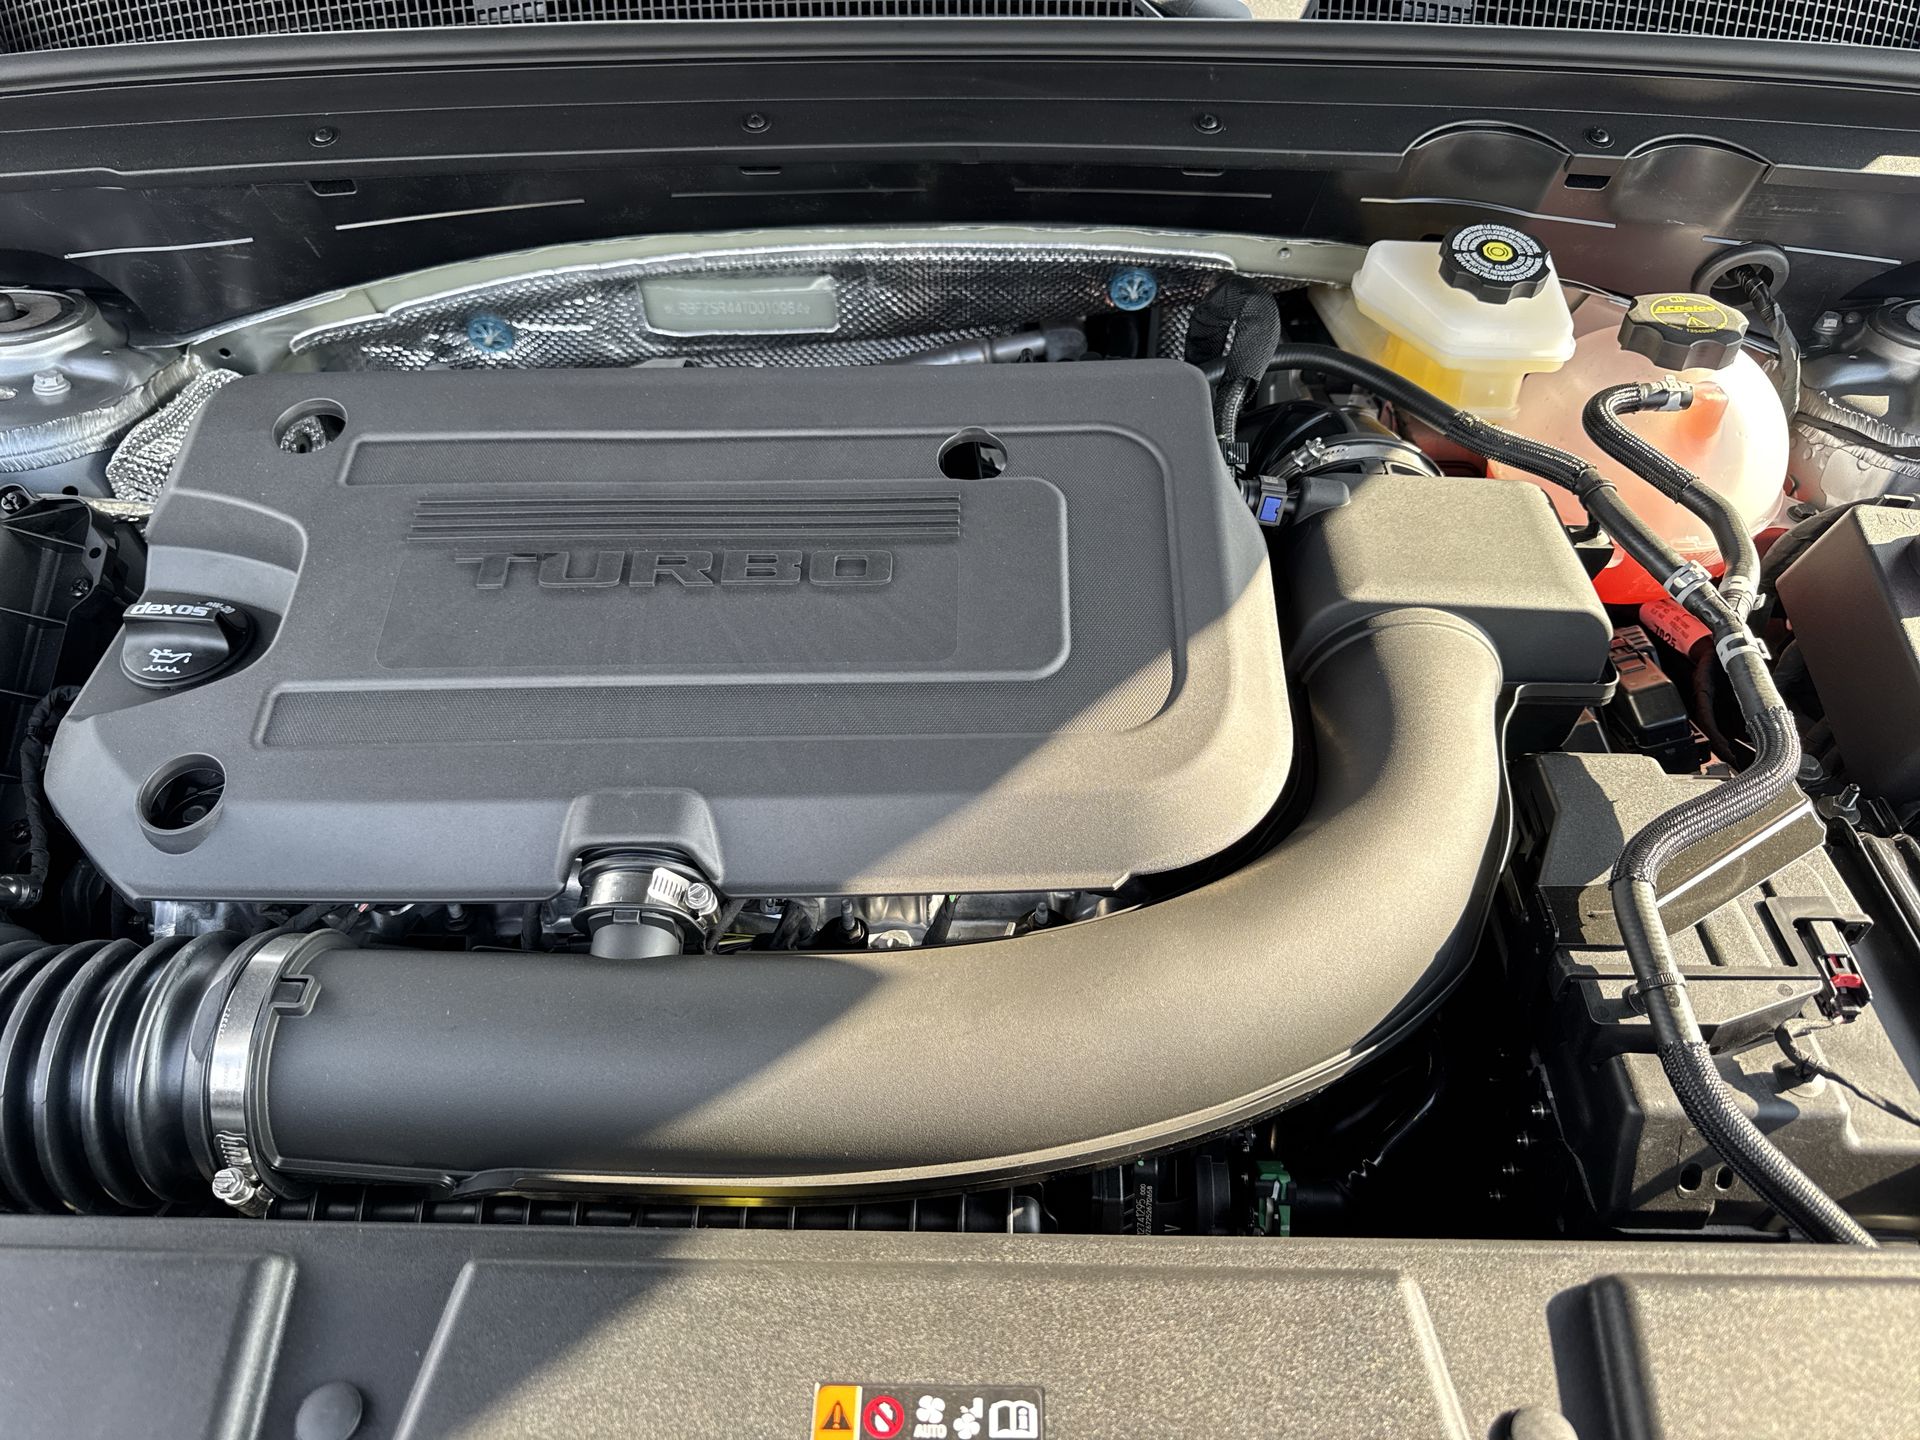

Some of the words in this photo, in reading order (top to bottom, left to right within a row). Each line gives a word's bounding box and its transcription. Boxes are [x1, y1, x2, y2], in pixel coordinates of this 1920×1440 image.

[1462, 262, 1480, 274] FLUID
[1477, 271, 1497, 280] FROM
[1655, 305, 1716, 313] ACDelco
[455, 549, 894, 589] TURBO
[130, 602, 209, 616] dexos
[913, 1424, 948, 1438] AUTO
